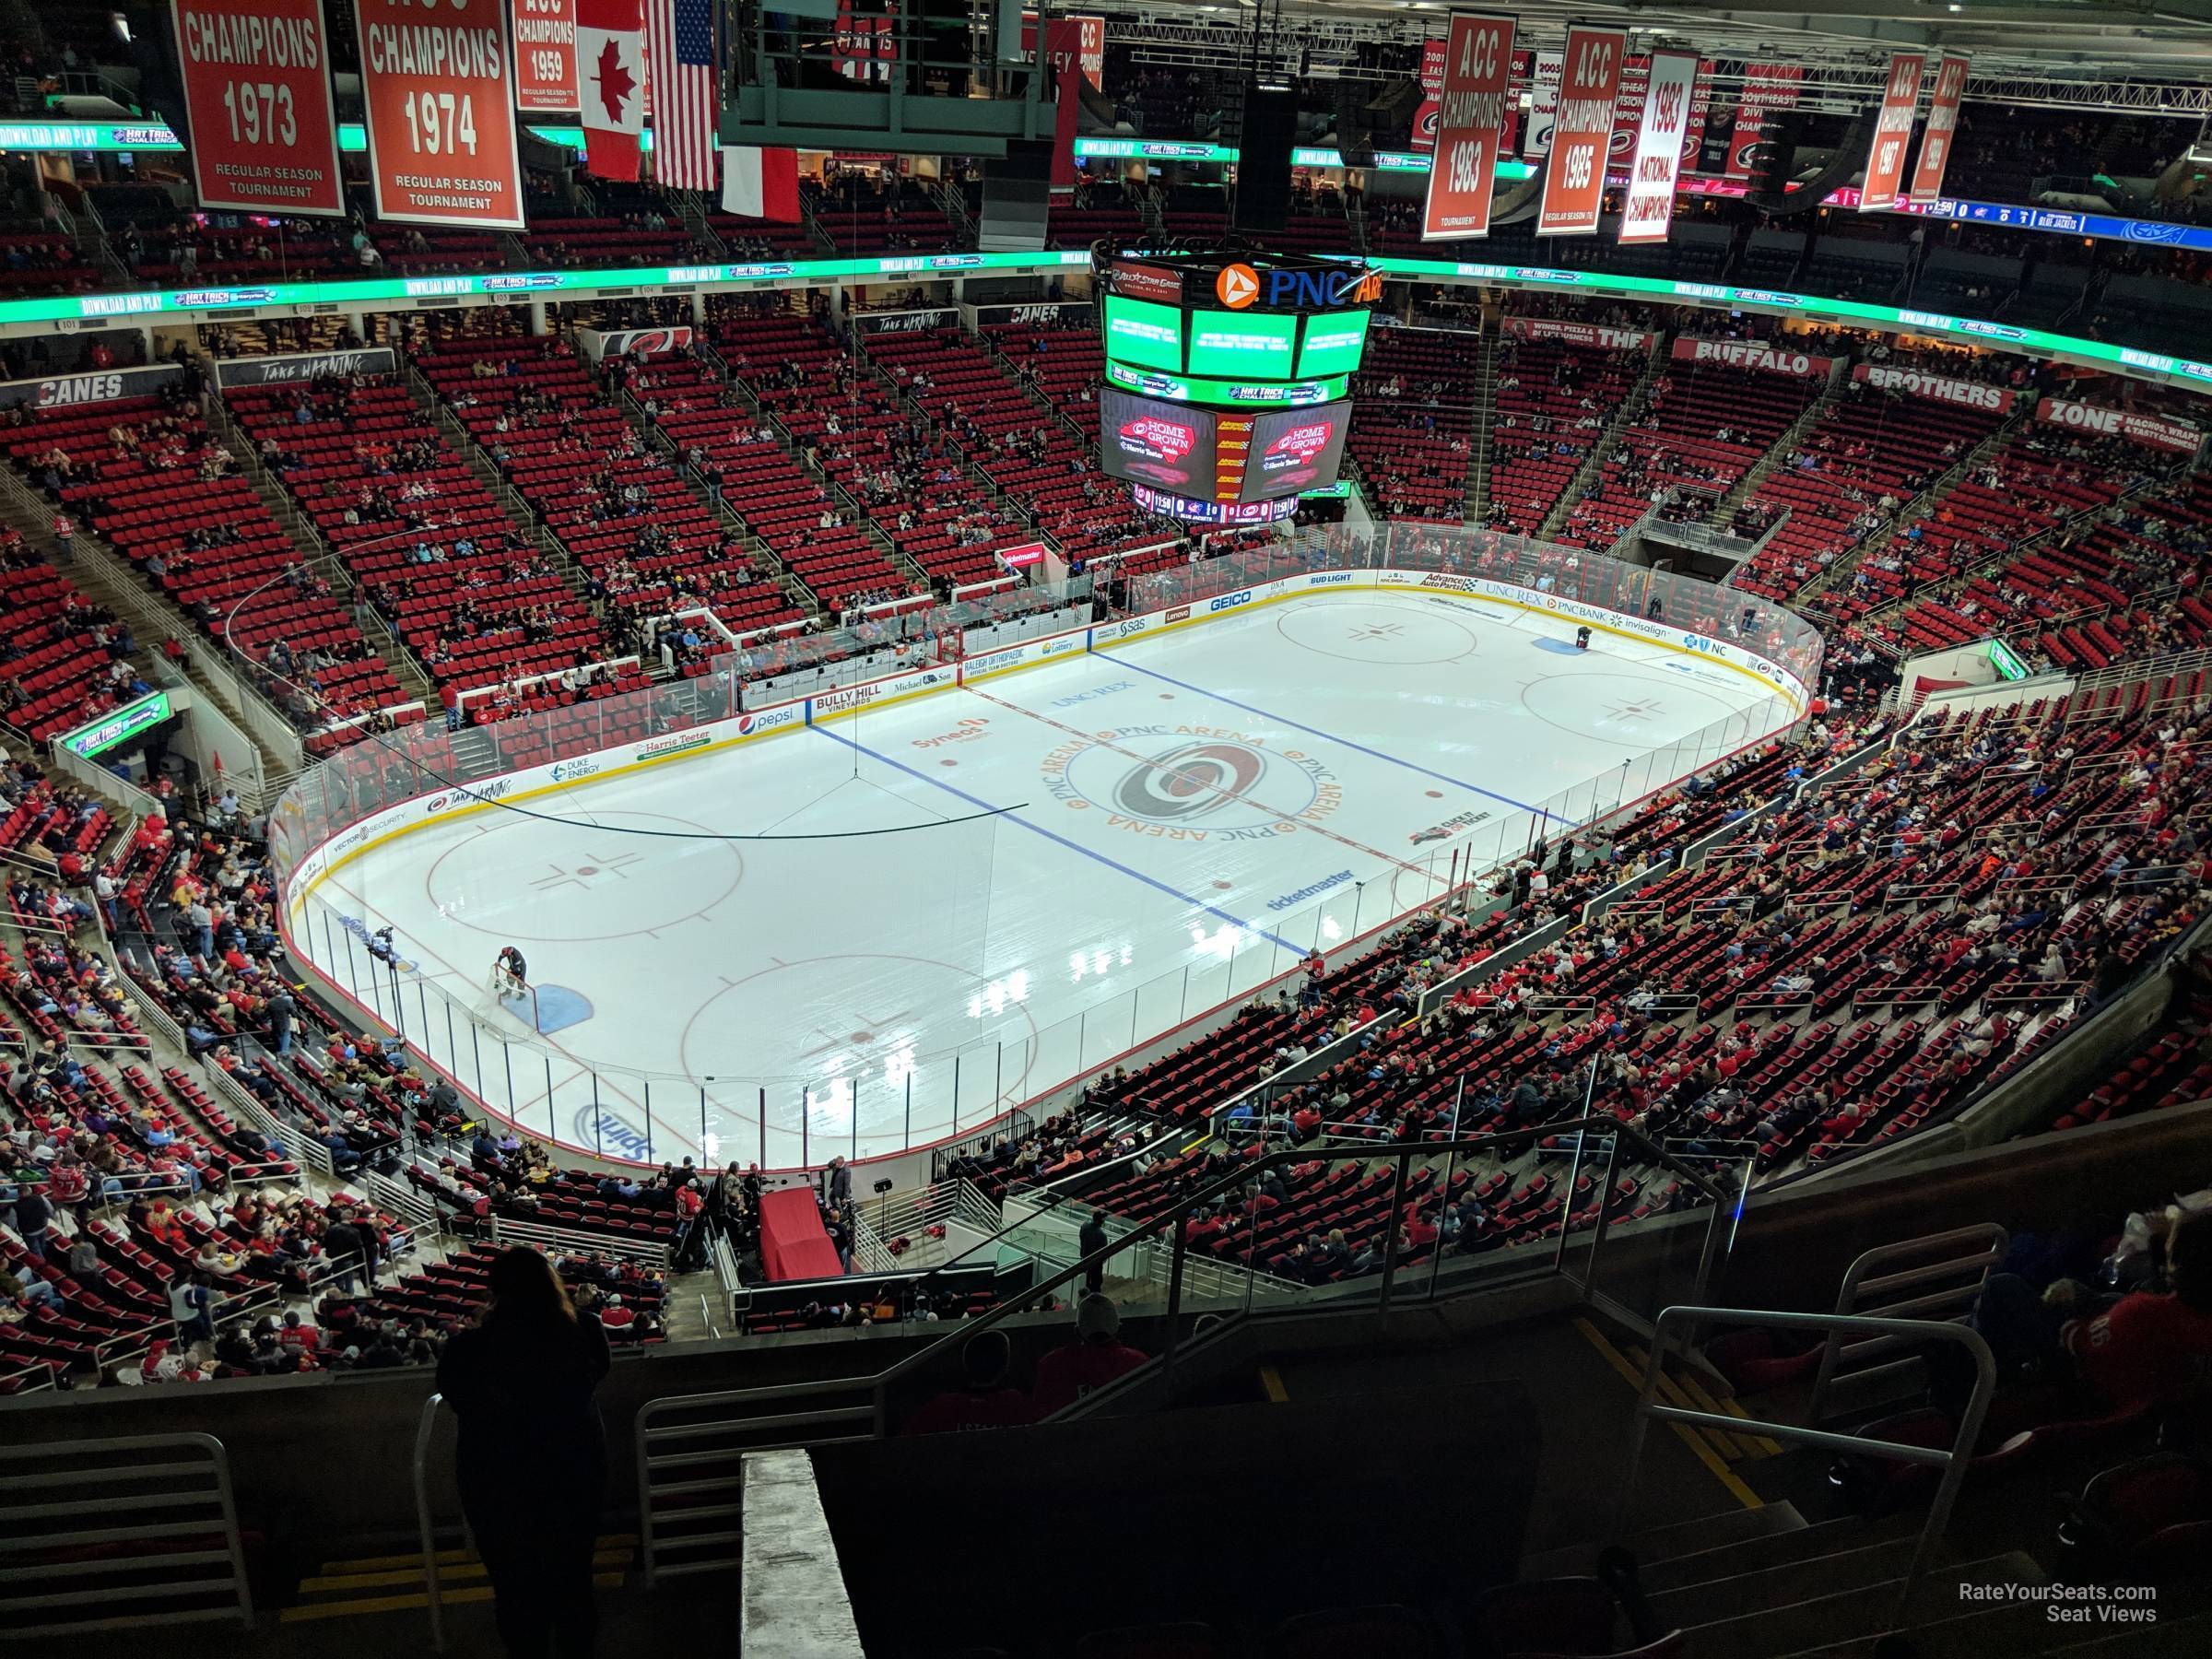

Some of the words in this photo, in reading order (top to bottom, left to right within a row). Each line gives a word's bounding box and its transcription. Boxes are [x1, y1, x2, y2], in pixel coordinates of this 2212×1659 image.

[185, 11, 317, 70] CHAMPIONS
[518, 19, 573, 44] CHAMPIONS
[370, 22, 500, 79] CHAMPIONS
[1459, 29, 1499, 79] ACC
[532, 50, 563, 82] 1959
[1539, 64, 1560, 74] 2005
[1575, 41, 1611, 88] ACC
[1892, 62, 1916, 98] ACC
[1940, 65, 1961, 98] ACC
[224, 80, 296, 147] 1973
[1442, 91, 1502, 129] CHAMPIONS
[1559, 99, 1612, 133] CHAMPIONS
[1652, 81, 1683, 133] 1983
[126, 129, 147, 138] HAT
[406, 92, 477, 155] 1974
[0, 127, 52, 147] DOWNLOAD
[53, 128, 72, 146] AND
[75, 129, 98, 147] PLAY
[216, 163, 272, 178] REGULAR
[275, 168, 323, 181] SEASON
[1449, 141, 1482, 193] 1983
[1563, 145, 1594, 189] 1985
[1638, 156, 1672, 182] NATIONAL
[229, 182, 312, 198] TOURNAMENT
[395, 175, 452, 190] REGULAR
[455, 179, 502, 192] SEASON
[409, 194, 491, 210] TOURNAMENT
[1629, 195, 1670, 222] CHAMPIONS
[1959, 204, 1969, 218] 0
[1441, 216, 1476, 227] TOURNAMENT
[1545, 213, 1566, 221] REGULAR
[1567, 211, 1584, 220] SEASON
[2038, 216, 2053, 227] BLUE
[2053, 218, 2077, 229] JACKETS
[186, 292, 204, 300] HAT
[206, 291, 229, 300] TRICK
[406, 279, 441, 296] DOWNLOAD
[456, 277, 472, 292] PLAY
[1268, 269, 1348, 307] PNC
[82, 296, 125, 314] DOWNLOAD
[127, 295, 143, 312] AND
[144, 294, 162, 312] PLAY
[186, 298, 229, 306] CHALLENGE
[879, 318, 900, 332] TAKE
[903, 312, 943, 330] WARNING
[1011, 305, 1060, 324] CANES
[63, 321, 76, 329] 101
[1534, 323, 1562, 332] WINGS,
[1564, 325, 1586, 334] PIZZA
[262, 363, 295, 381] TAKE
[302, 354, 362, 377] WARNING
[1696, 342, 1809, 373] BUFFALO
[39, 375, 123, 406] CANES
[1868, 367, 2002, 408] BROTHERS
[2049, 401, 2124, 433] ZONE
[1148, 420, 1185, 439] HOME
[1293, 427, 1325, 441] HOME
[2124, 417, 2167, 434] NACHOS,
[2169, 427, 2200, 443] WRAPS
[2124, 425, 2132, 433] &
[2133, 428, 2159, 440] TASTY
[2159, 433, 2198, 452] GOODNESS
[1127, 444, 1145, 454] Harris
[1148, 432, 1189, 449] GROWN
[1291, 437, 1325, 450] GROWN
[1269, 461, 1285, 469] Harris
[1176, 499, 1184, 512] 0
[1006, 550, 1041, 564] ticketmaster
[1311, 576, 1326, 584] BUD
[1328, 573, 1352, 582] LIGHT
[1426, 573, 1464, 584] Advance
[1440, 582, 1461, 591] Parts
[1210, 591, 1251, 612] GEICO
[1486, 582, 1515, 598] UNC
[1517, 591, 1543, 606] REX
[1167, 609, 1189, 620] Lenovo
[1558, 601, 1578, 616] PNC
[1579, 606, 1606, 621] BANK
[1127, 618, 1146, 632] sas
[1625, 618, 1666, 638] invisalign
[1052, 641, 1074, 653] Lottery
[1712, 645, 1728, 657] NC
[965, 657, 987, 672] RALEIGH
[988, 648, 1024, 665] ORTHOPAEDIC
[895, 677, 922, 693] Michael
[938, 673, 951, 681] Son
[817, 689, 853, 710] BULLY
[856, 685, 881, 702] HILL
[829, 697, 871, 712] VINEYARDS
[1052, 690, 1089, 708] UNC
[1093, 681, 1135, 700] REX
[758, 708, 794, 730] pepsi
[85, 731, 100, 747] HAT
[101, 721, 123, 740] TRICK
[646, 737, 677, 752] Harris
[679, 731, 710, 745] Teeter
[912, 727, 982, 748] Syneos
[1114, 725, 1166, 737] PNC
[1175, 725, 1265, 747] ARENA
[568, 759, 589, 771] DUKE
[1041, 740, 1092, 774] ARENA
[568, 764, 600, 780] ENERGY
[1298, 759, 1335, 782] PNC
[472, 780, 512, 805] WARNING
[1042, 777, 1077, 801] PNC
[1299, 782, 1342, 821] ARENA
[1107, 815, 1208, 841] ARENA
[1441, 817, 1466, 829] CLICK
[1464, 811, 1491, 827] TICKET
[335, 834, 359, 853] VECTOR
[369, 812, 406, 832] SECURITY
[1219, 826, 1281, 841] PNC
[1267, 869, 1355, 912] ticketmaster
